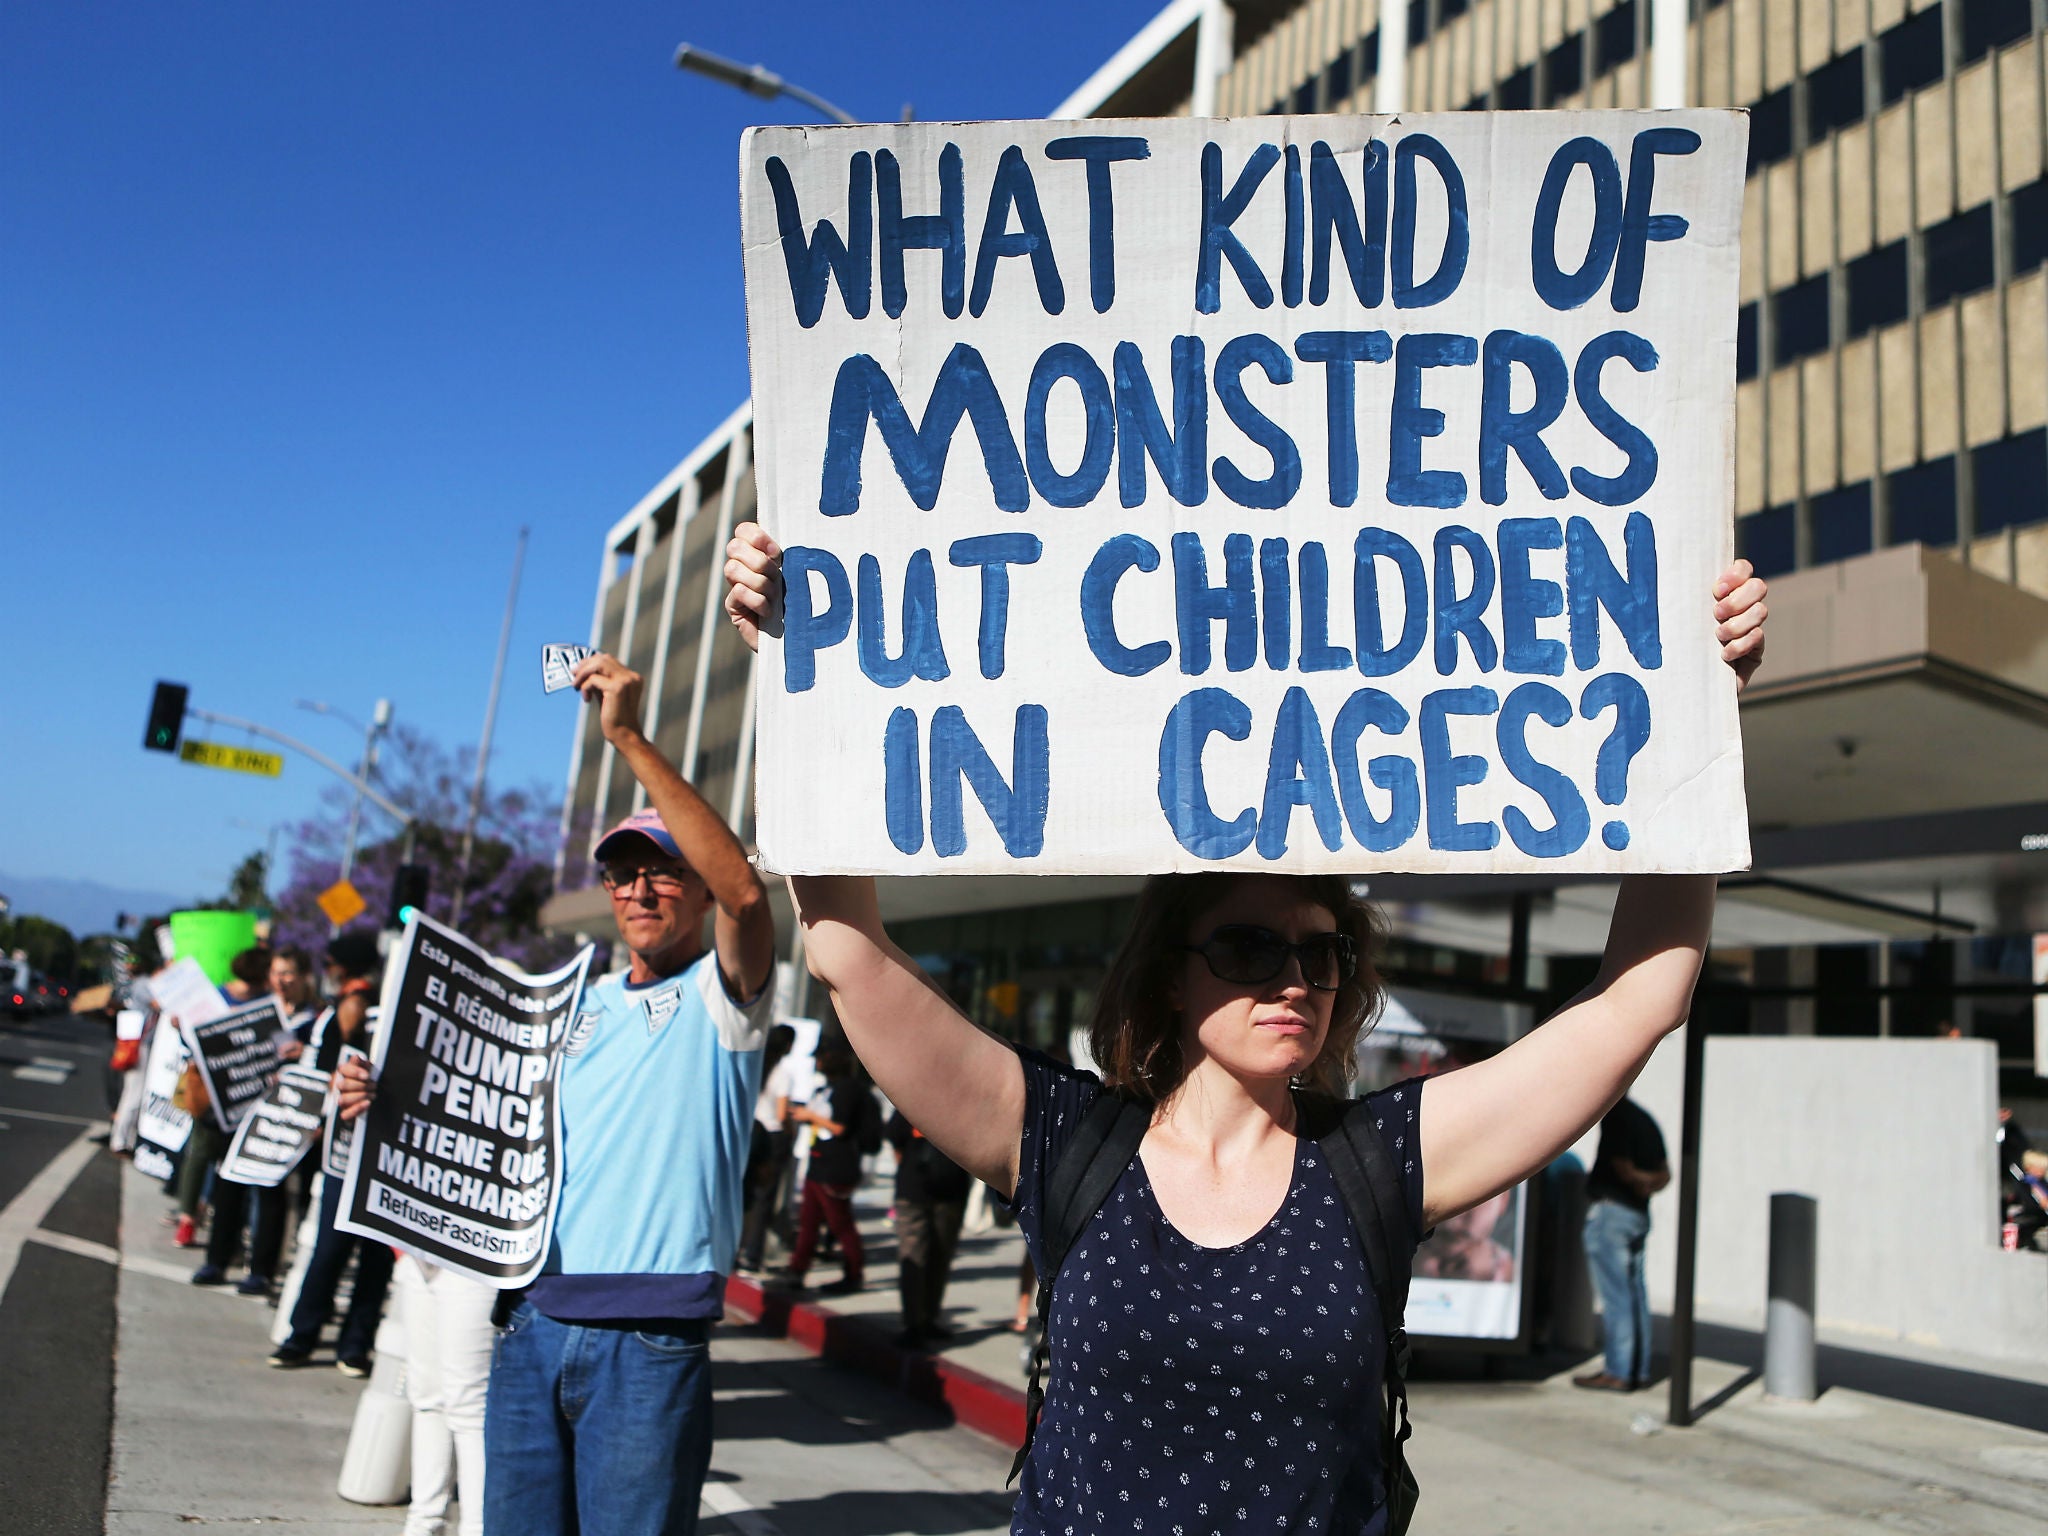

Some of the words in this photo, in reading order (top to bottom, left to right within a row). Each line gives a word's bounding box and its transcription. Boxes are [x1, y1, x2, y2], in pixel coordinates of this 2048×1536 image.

[768, 136, 1152, 327] WHAT
[1194, 133, 1470, 314] KIND
[1532, 127, 1702, 313] OF
[820, 330, 1660, 516] MONSTERS
[782, 532, 1043, 693] PUT
[1080, 511, 1663, 679] CHILDREN
[884, 704, 1050, 858] IN
[1158, 672, 1652, 860] CAGES?
[420, 939, 451, 968] Esta
[424, 973, 449, 1008] EL
[453, 992, 548, 1049] RÉGIMEN
[398, 1112, 495, 1173] ¡TIENE
[500, 1143, 547, 1185] QUE
[418, 1062, 546, 1142] PENCE
